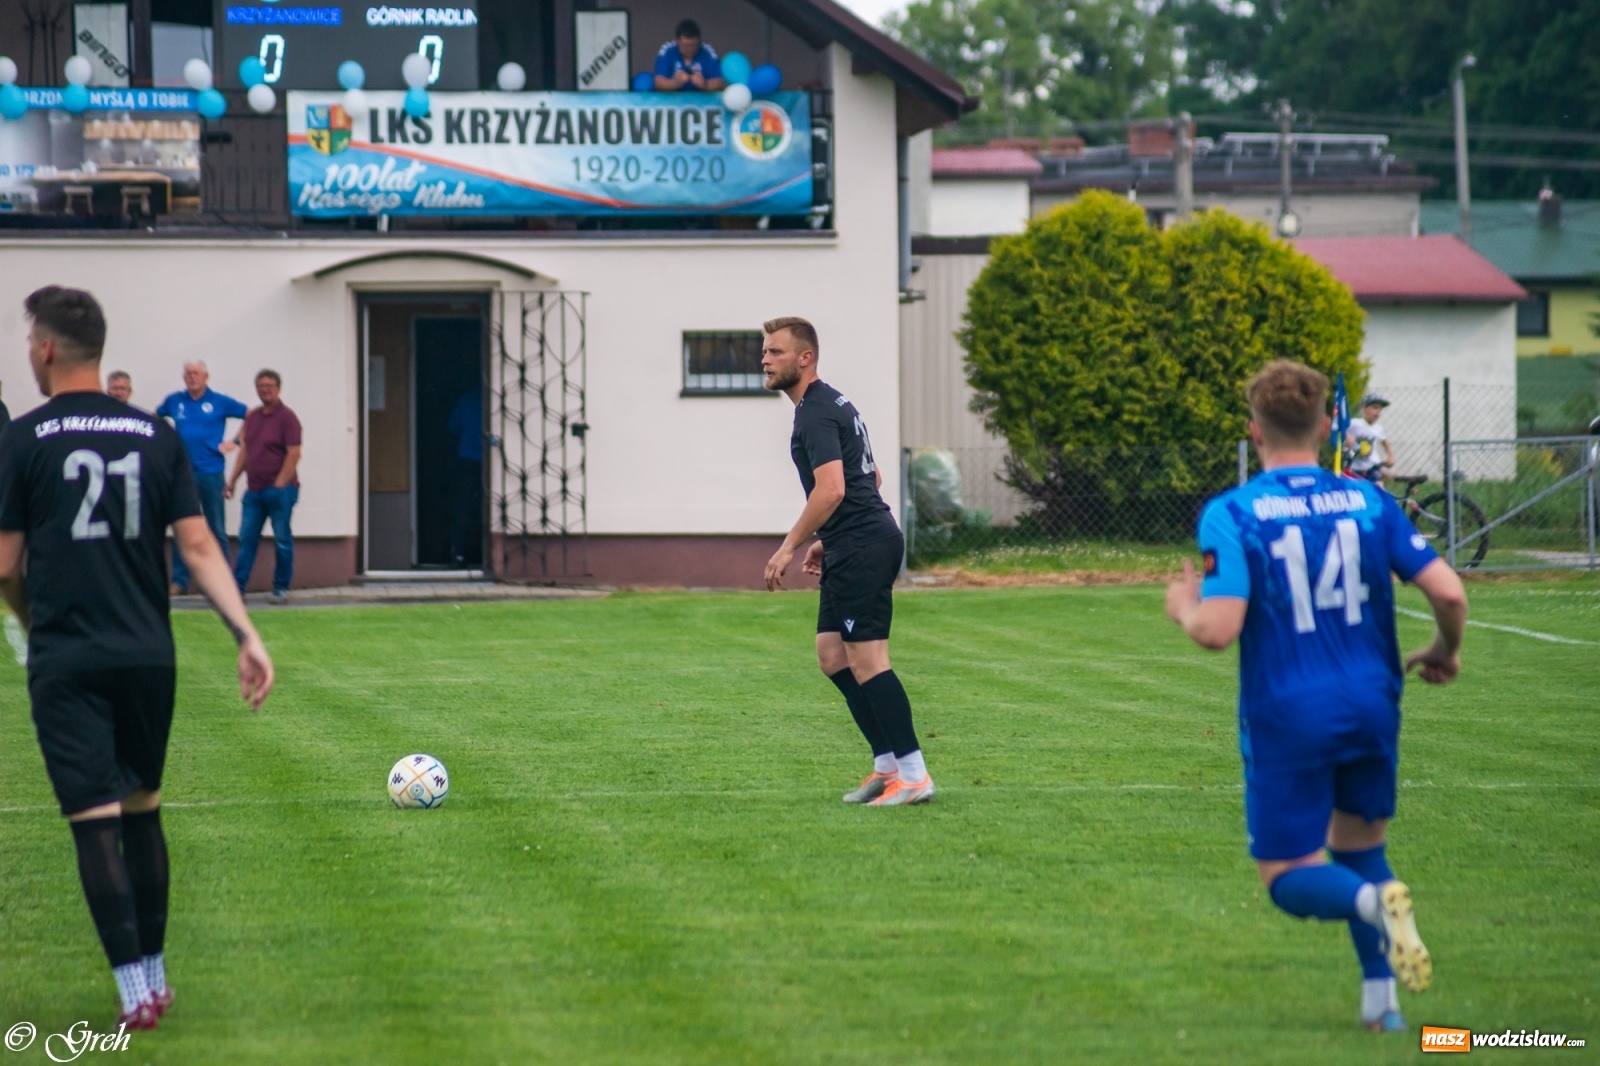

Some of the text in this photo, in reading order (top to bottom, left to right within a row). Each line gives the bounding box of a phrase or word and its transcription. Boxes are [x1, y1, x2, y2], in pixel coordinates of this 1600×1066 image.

[366, 5, 424, 26] GÓRNIK
[77, 28, 130, 79] BINGO
[259, 34, 286, 83] 0
[579, 35, 627, 87] BINGO
[369, 101, 723, 145] LKS KRZYŻANOWICE
[571, 155, 726, 182] 1920-2020
[35, 418, 61, 438] LKS
[63, 449, 141, 540] 21
[1252, 490, 1367, 521] GÓRNIK RADLIN
[1270, 518, 1370, 633] 14
